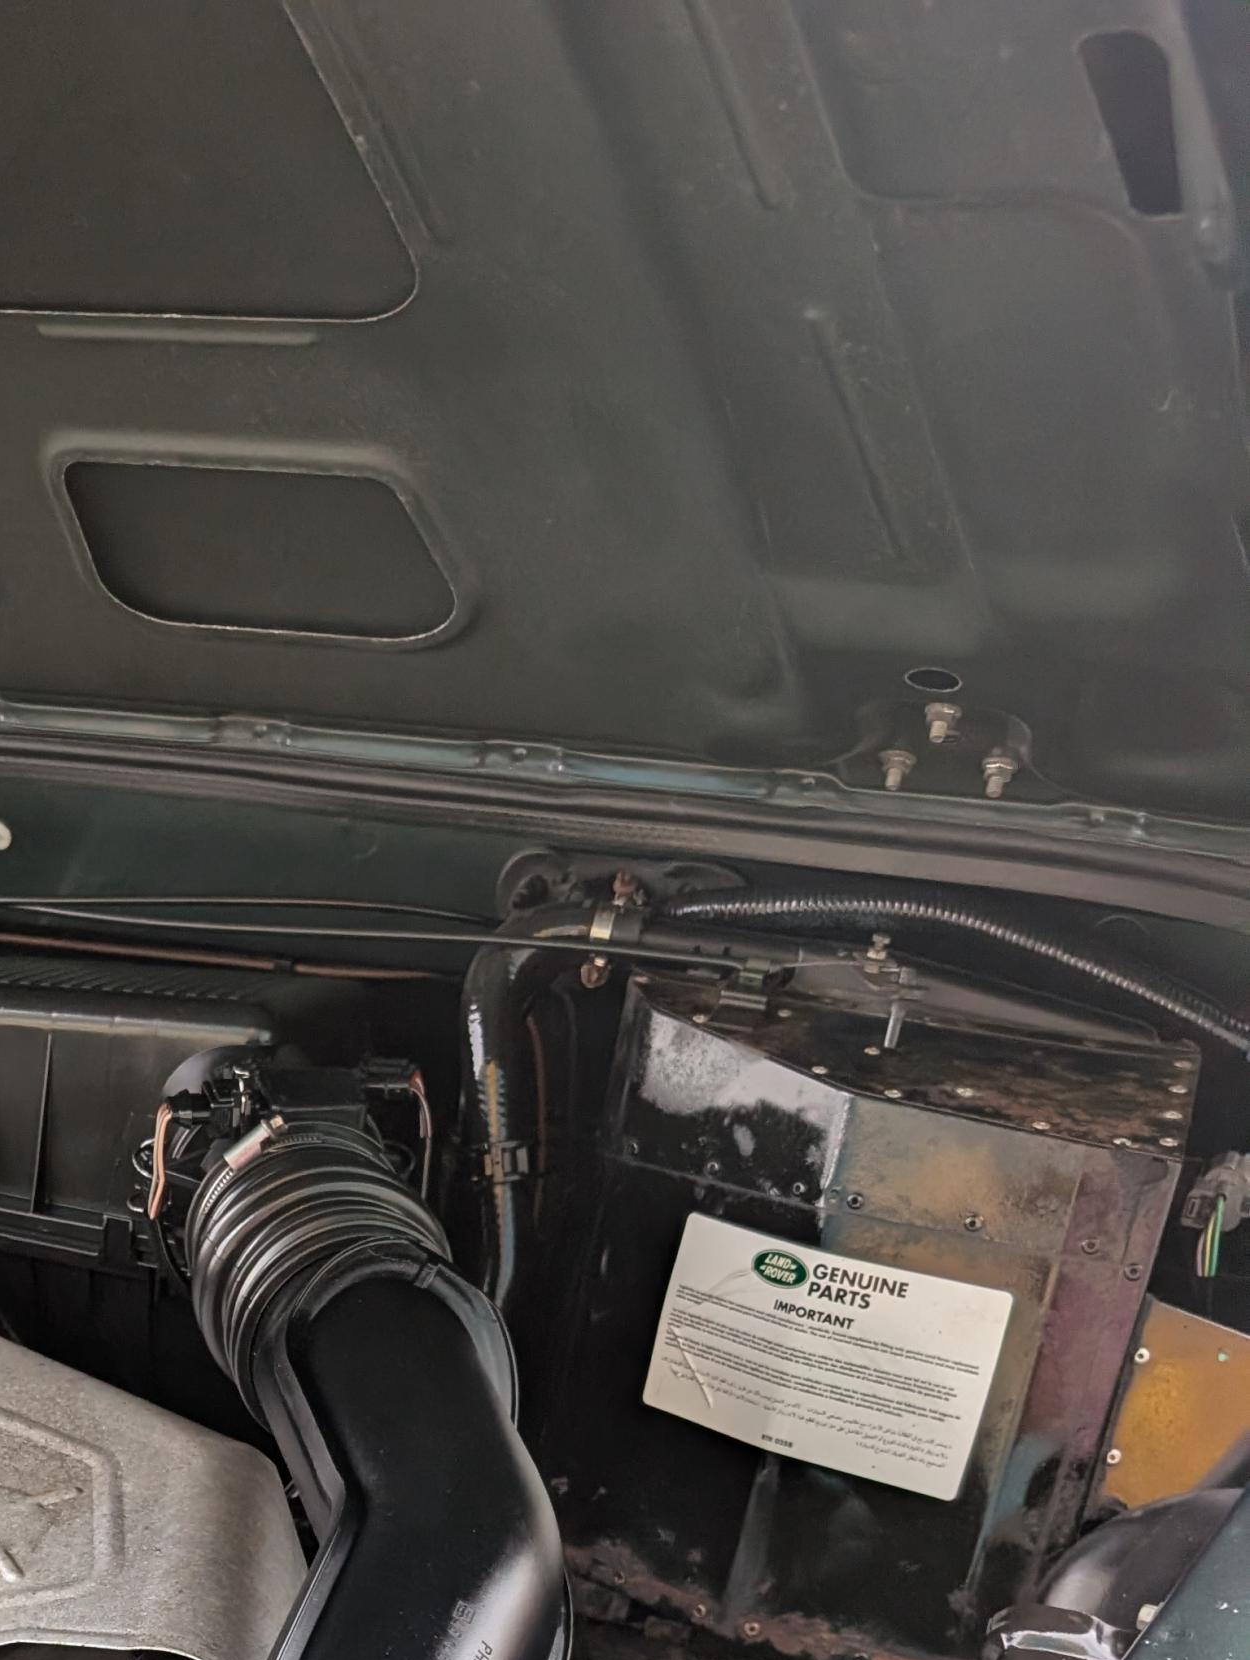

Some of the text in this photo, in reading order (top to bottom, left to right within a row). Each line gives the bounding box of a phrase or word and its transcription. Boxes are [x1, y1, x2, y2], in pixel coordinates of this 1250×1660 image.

[763, 1266, 797, 1284] ROVER
[764, 1253, 792, 1270] LAND
[807, 1281, 871, 1309] PARTS
[813, 1264, 909, 1298] GENUINE
[773, 1299, 855, 1330] IMPORTANT
